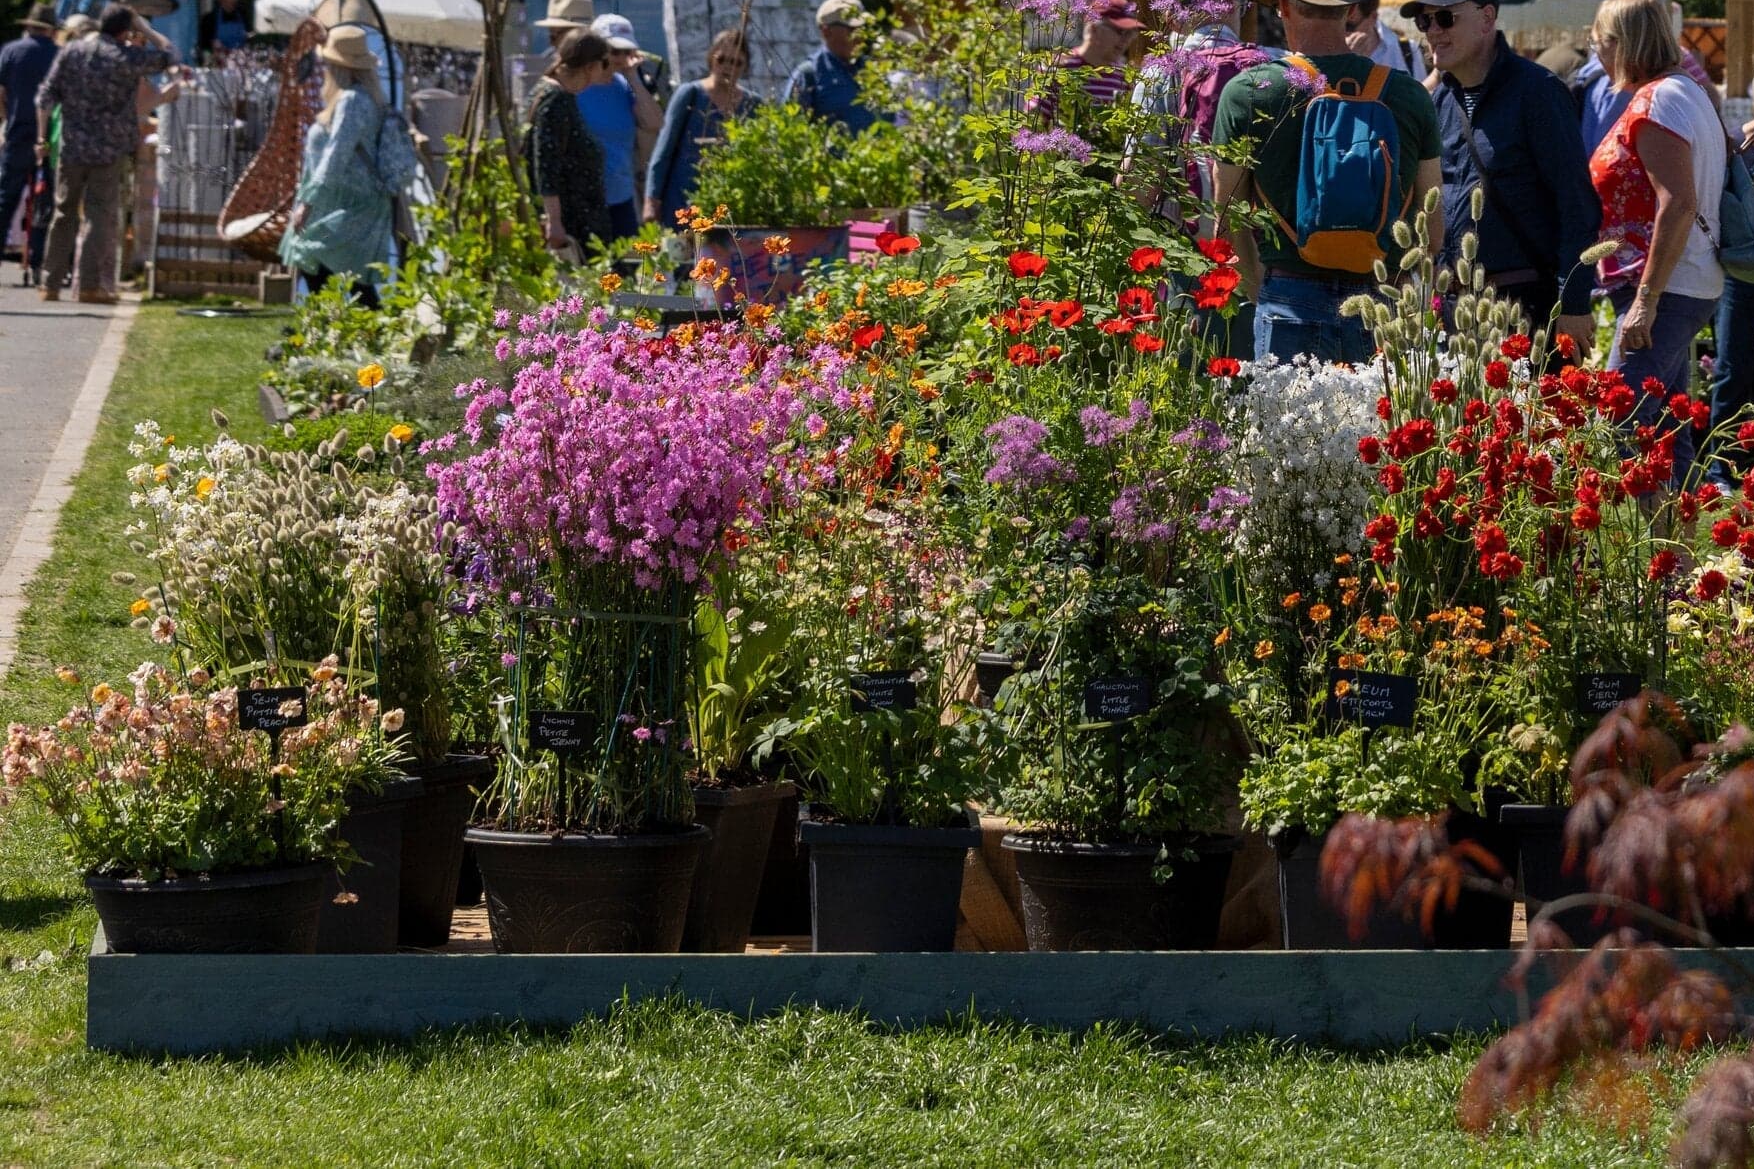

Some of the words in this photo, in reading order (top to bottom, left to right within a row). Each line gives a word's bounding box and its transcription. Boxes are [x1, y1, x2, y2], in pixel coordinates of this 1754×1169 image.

[1587, 690, 1618, 700] FIERY
[1340, 696, 1395, 710] ETTICOATS
[550, 737, 581, 747] JENNY
